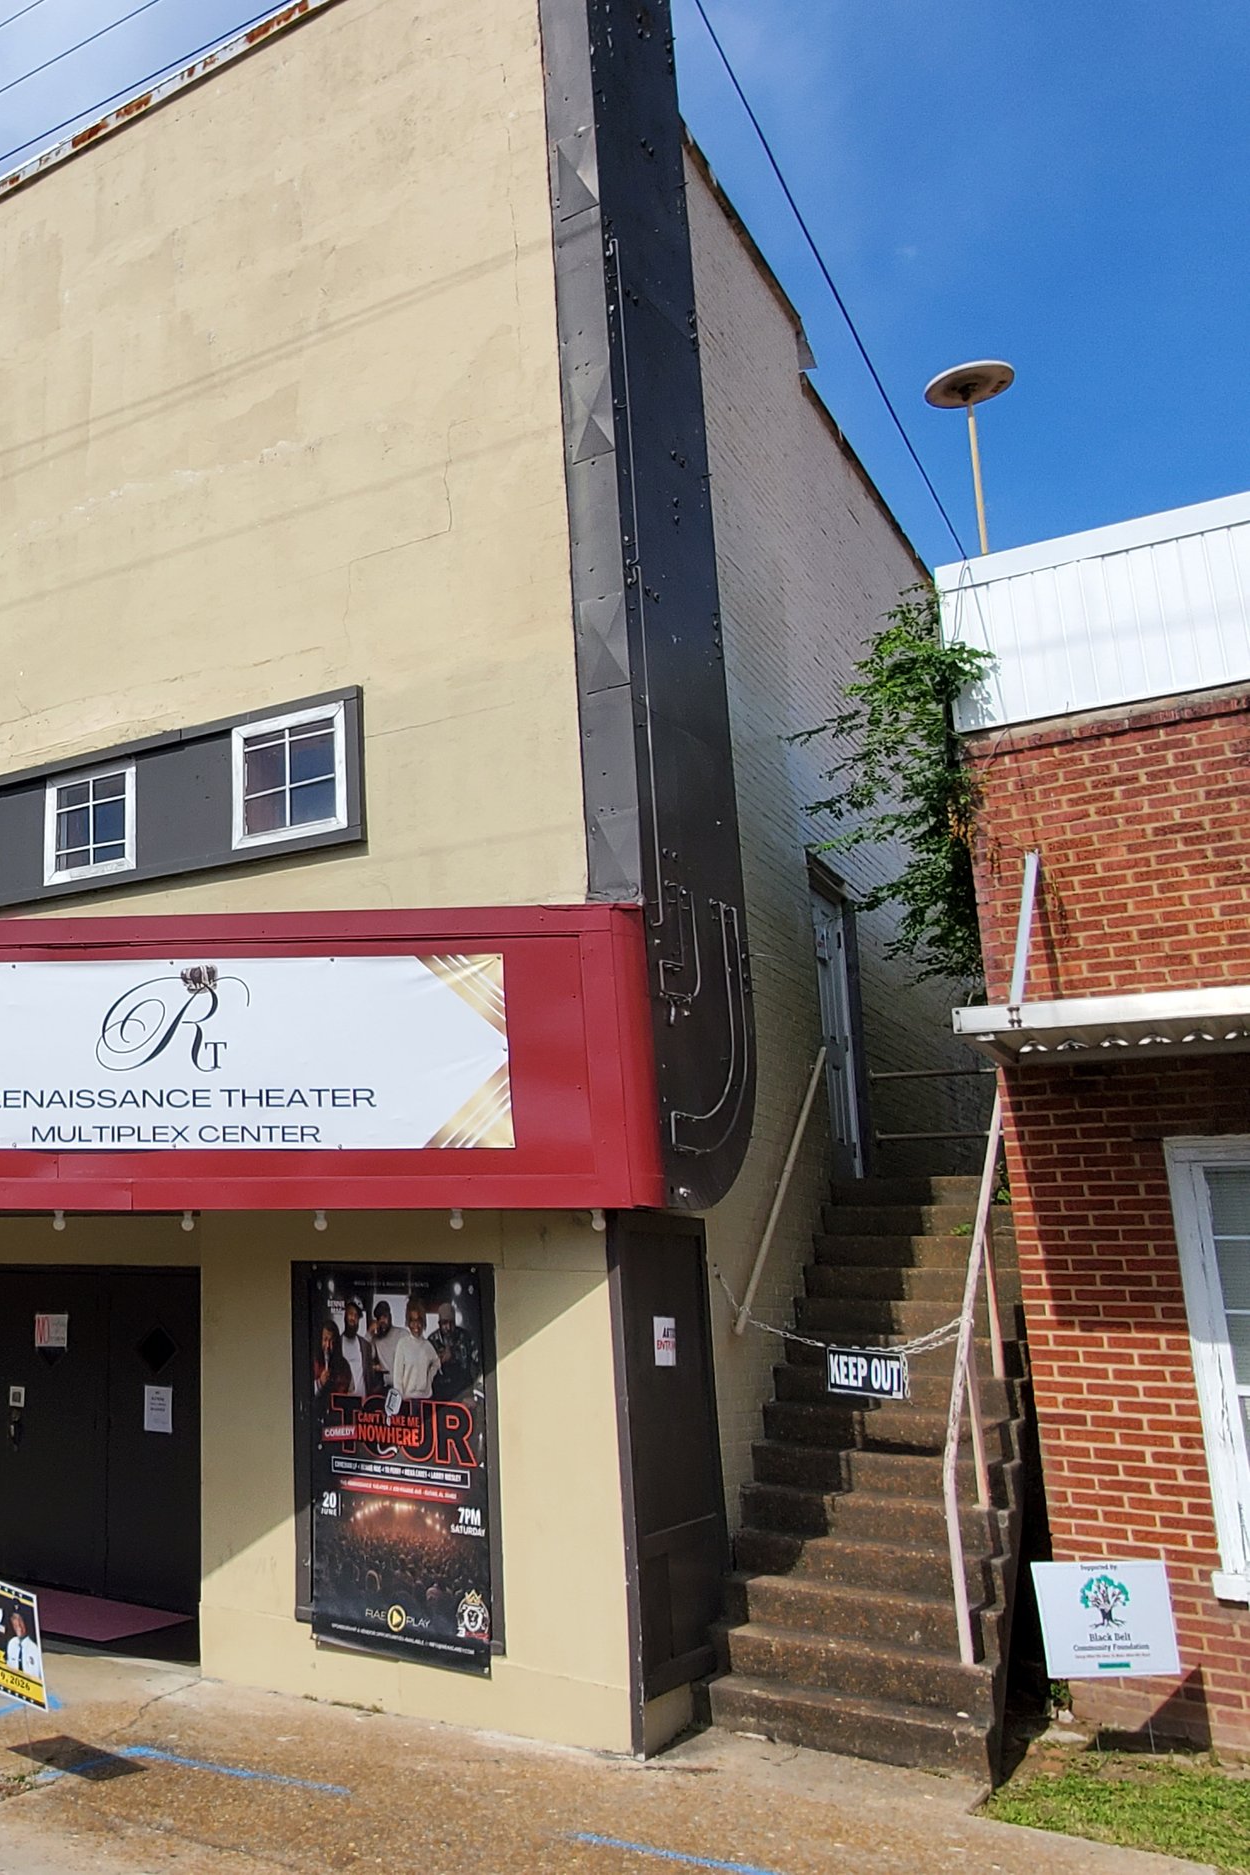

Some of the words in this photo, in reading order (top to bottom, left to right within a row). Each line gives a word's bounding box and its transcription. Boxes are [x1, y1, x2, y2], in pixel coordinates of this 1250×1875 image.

[220, 1087, 376, 1109] THEATER
[31, 1125, 190, 1143] MULTIPLEX
[198, 1124, 321, 1143] CENTER
[829, 1354, 868, 1387] KEEP
[871, 1357, 901, 1391] OUT
[324, 1426, 356, 1437] COMEDY
[331, 1392, 478, 1467] TOUR
[358, 1423, 420, 1447] NOWHERE
[322, 1491, 337, 1508] 20
[321, 1507, 337, 1516] JUNE
[457, 1507, 482, 1526] 7PM
[450, 1523, 485, 1537] SATURDAY
[365, 1608, 386, 1621] RAE
[406, 1615, 431, 1628] PLAY
[1089, 1632, 1113, 1642] Black
[1114, 1631, 1131, 1641] Belt
[1112, 1642, 1150, 1651] Foundation
[9, 1674, 31, 1692] 2026
